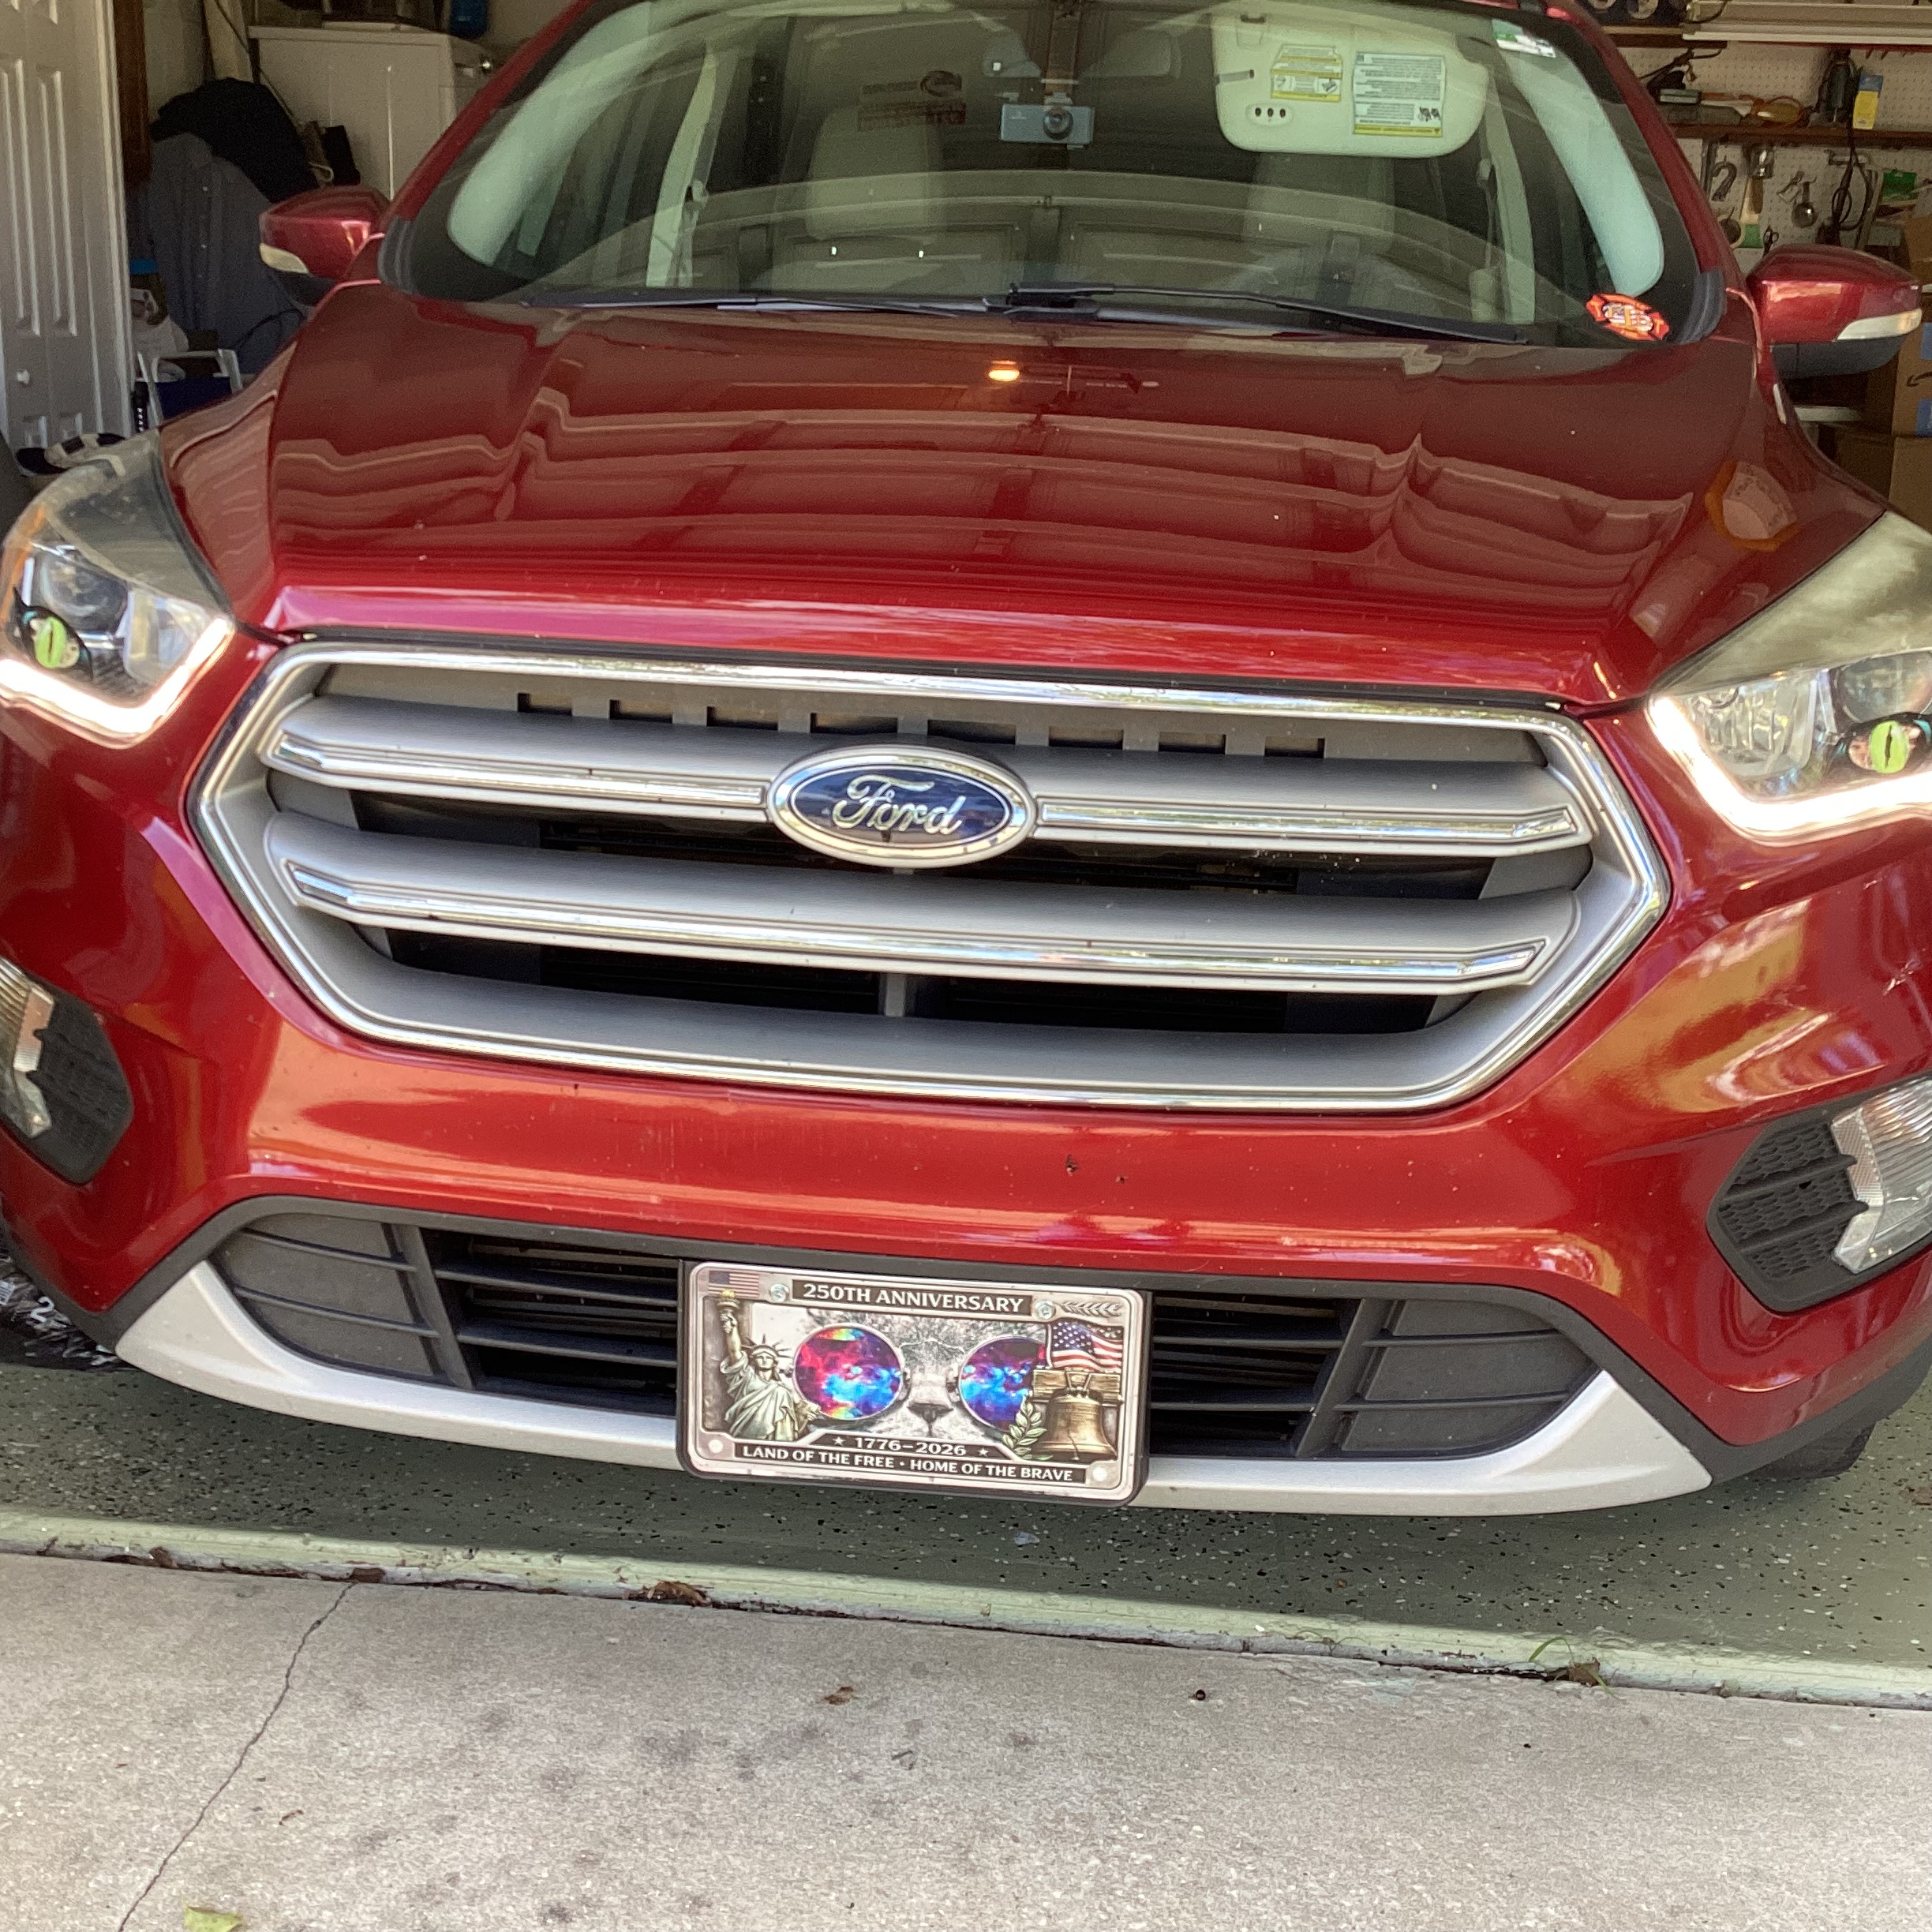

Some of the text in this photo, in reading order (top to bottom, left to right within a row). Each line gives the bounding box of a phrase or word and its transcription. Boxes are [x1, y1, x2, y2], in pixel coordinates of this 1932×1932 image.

[832, 774, 967, 835] Ford
[803, 1283, 1024, 1312] 250TH ANNIVERSARY
[743, 1446, 1073, 1481] LAND OF THE FREE HOME OF THE BRAVE
